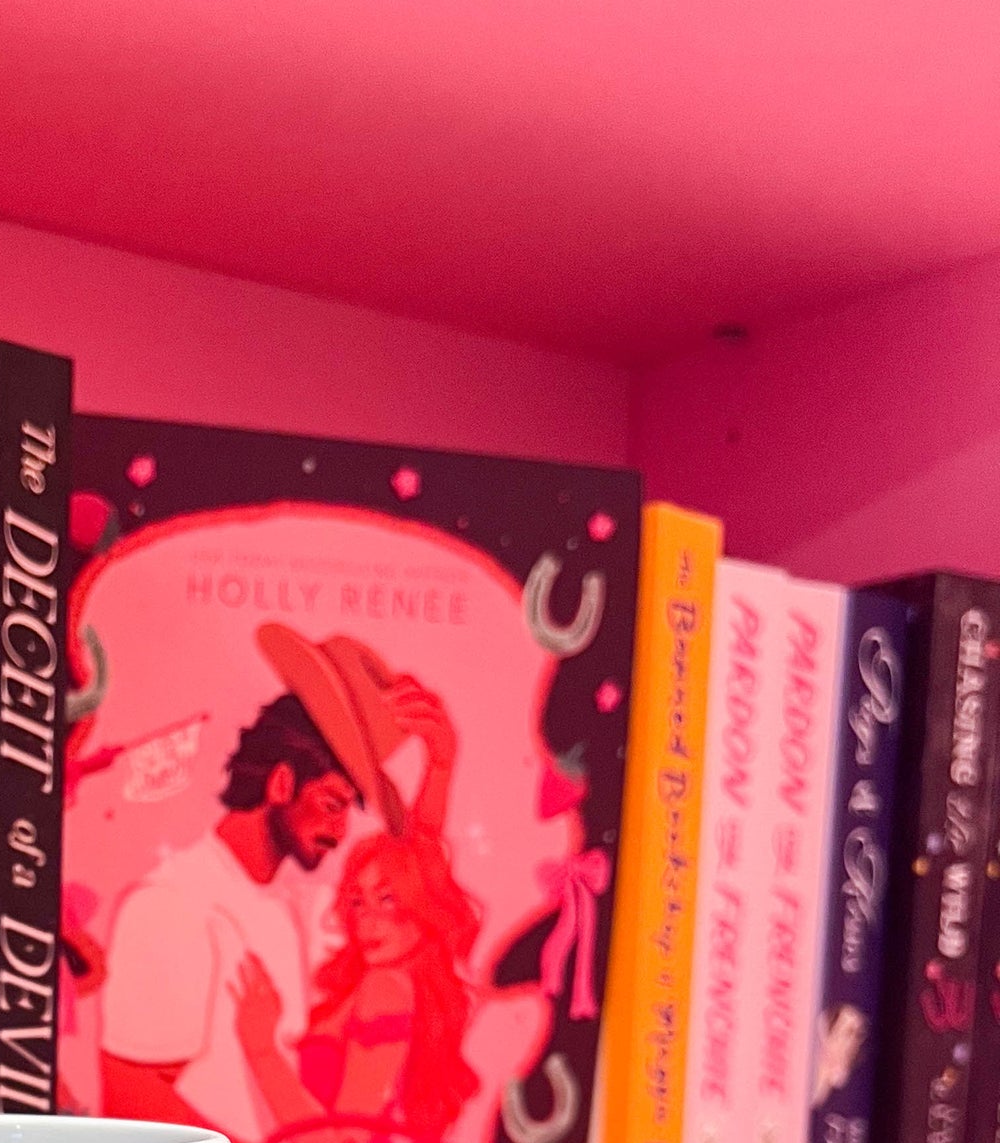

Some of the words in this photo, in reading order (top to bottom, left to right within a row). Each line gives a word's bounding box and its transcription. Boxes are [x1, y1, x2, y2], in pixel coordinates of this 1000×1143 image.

[20, 419, 57, 496] The
[186, 573, 322, 612] HOLLY
[0, 505, 59, 794] DECEIT
[950, 608, 989, 786] CHASING
[722, 593, 761, 806] PARDON
[778, 609, 818, 815] PARDON
[7, 818, 47, 867] of
[11, 864, 37, 889] a
[937, 862, 971, 958] WILD
